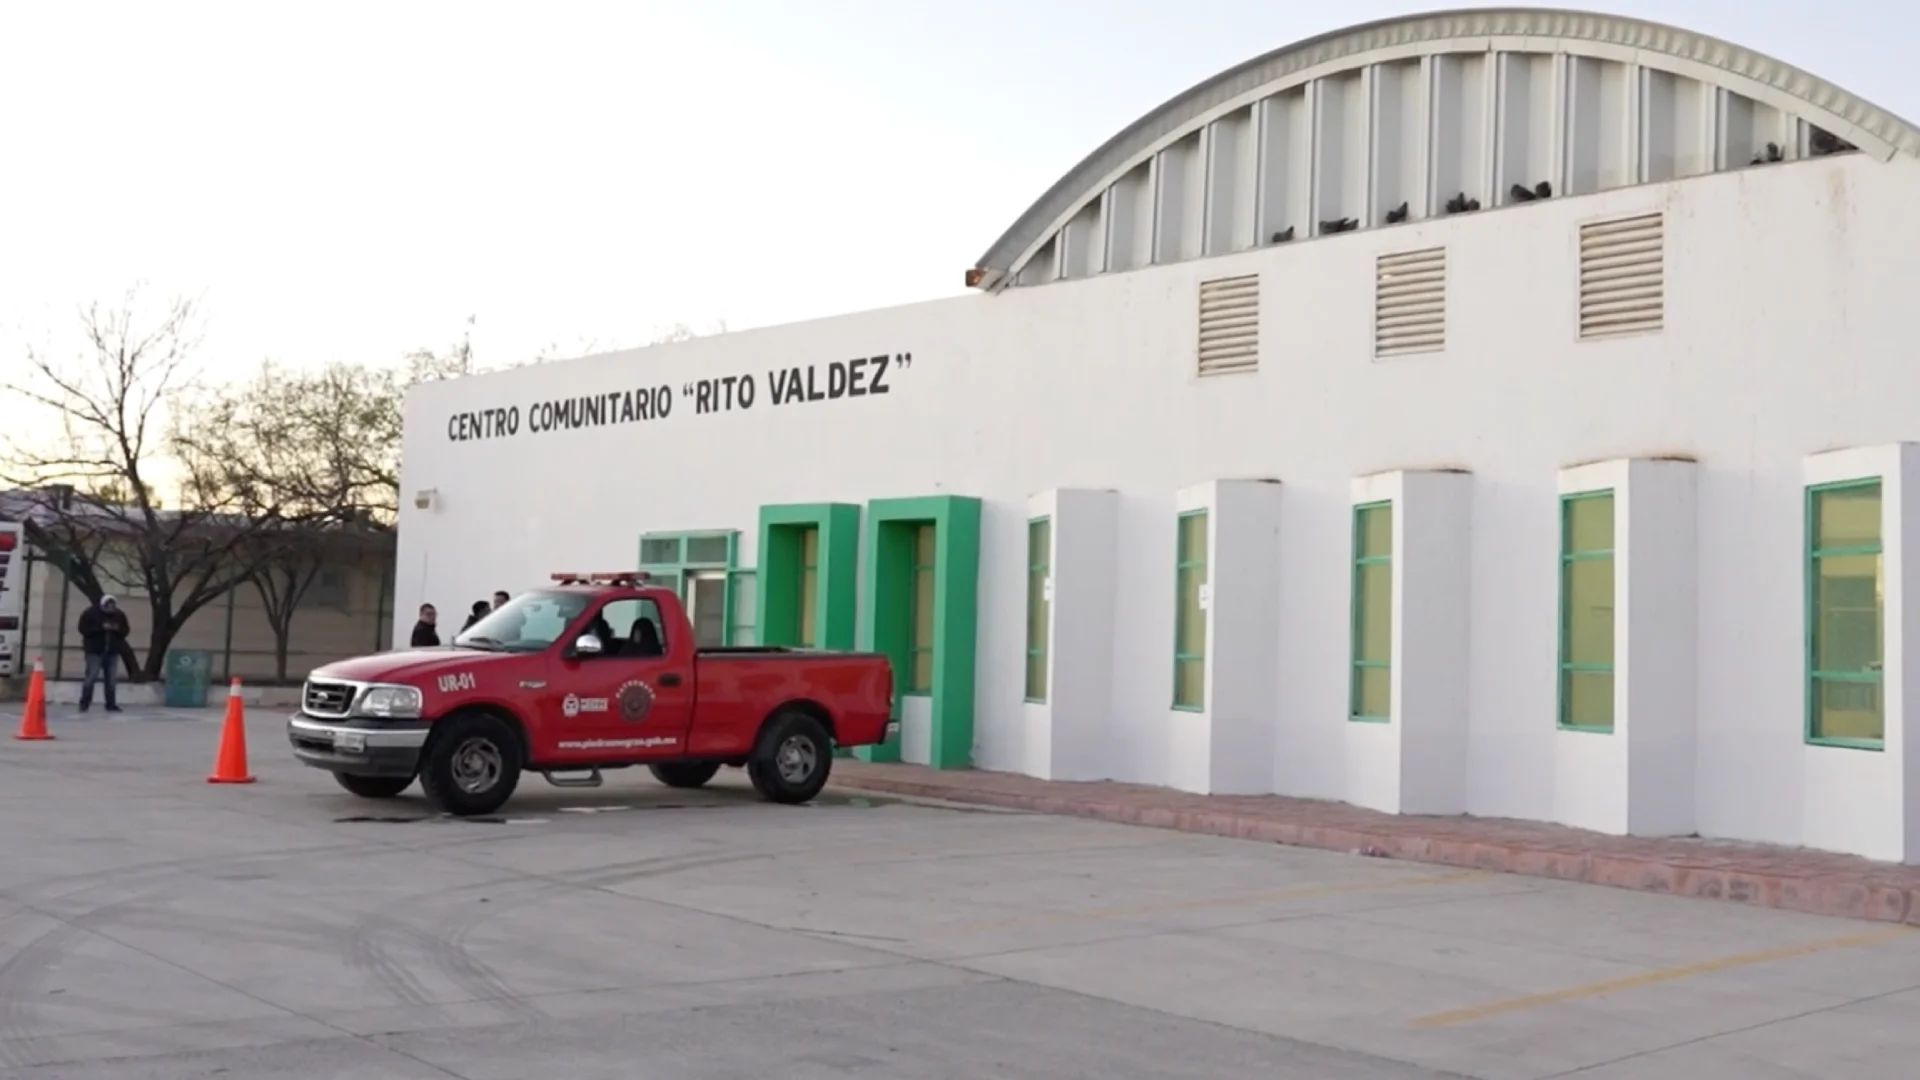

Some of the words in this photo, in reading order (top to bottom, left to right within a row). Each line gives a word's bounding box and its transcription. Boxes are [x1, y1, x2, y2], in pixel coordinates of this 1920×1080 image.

[448, 406, 520, 442] CENTRO
[529, 384, 672, 433] COMUNITARIO
[437, 671, 476, 693] UR-01
